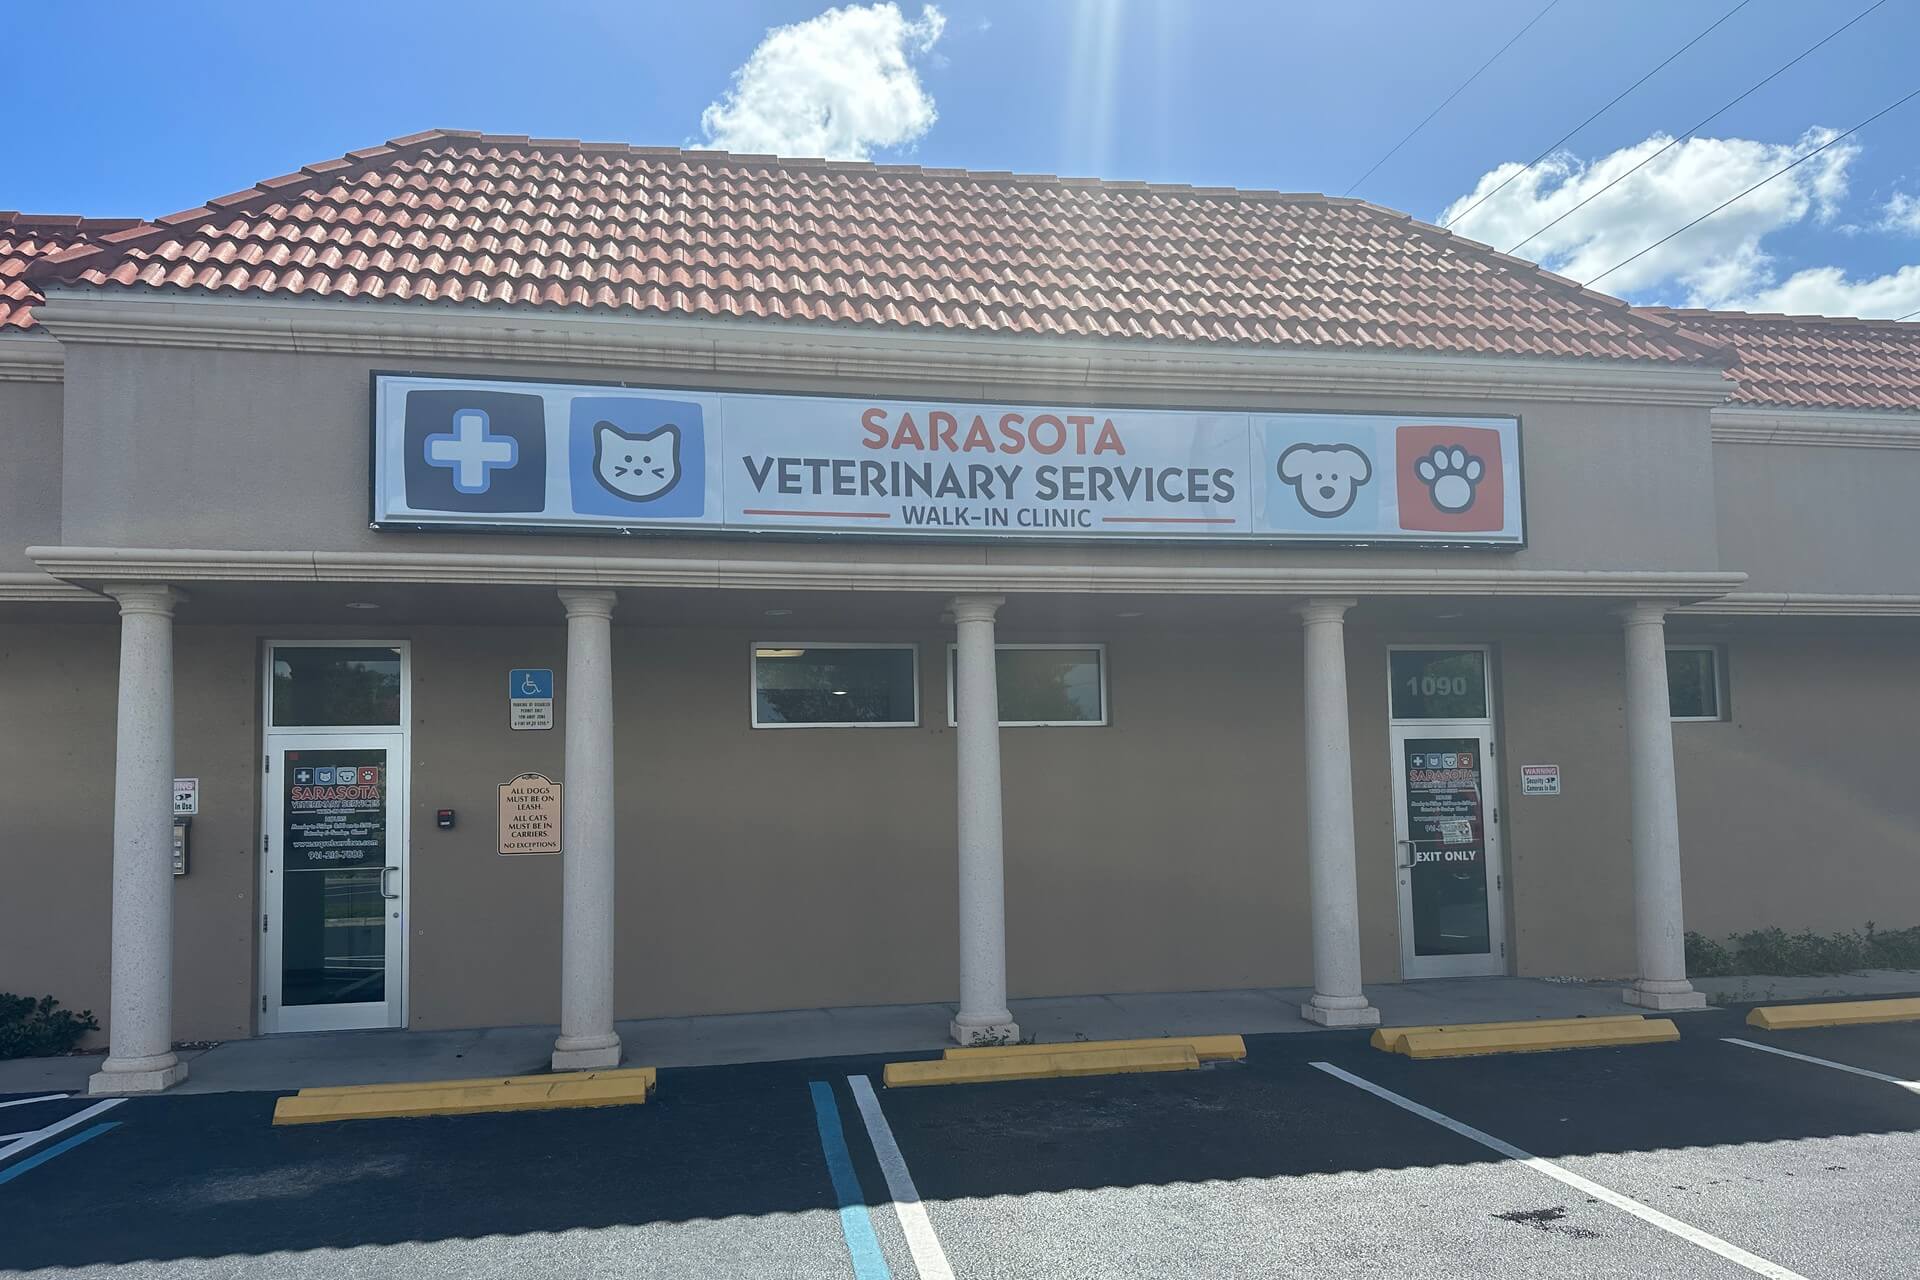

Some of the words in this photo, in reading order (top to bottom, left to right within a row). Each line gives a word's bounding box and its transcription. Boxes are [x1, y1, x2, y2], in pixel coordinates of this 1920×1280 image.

[861, 408, 1126, 456] SARASOTA
[742, 455, 1023, 501] VETERINARY
[1035, 465, 1236, 504] SERVICES
[902, 504, 1008, 528] WALK-IN
[1016, 507, 1092, 529] CLINIC
[1406, 676, 1467, 696] 1090
[1410, 769, 1473, 781] SARASOTA
[292, 786, 380, 800] SARASOTA
[1416, 852, 1442, 862] EXIT
[1444, 851, 1476, 861] ONLY
